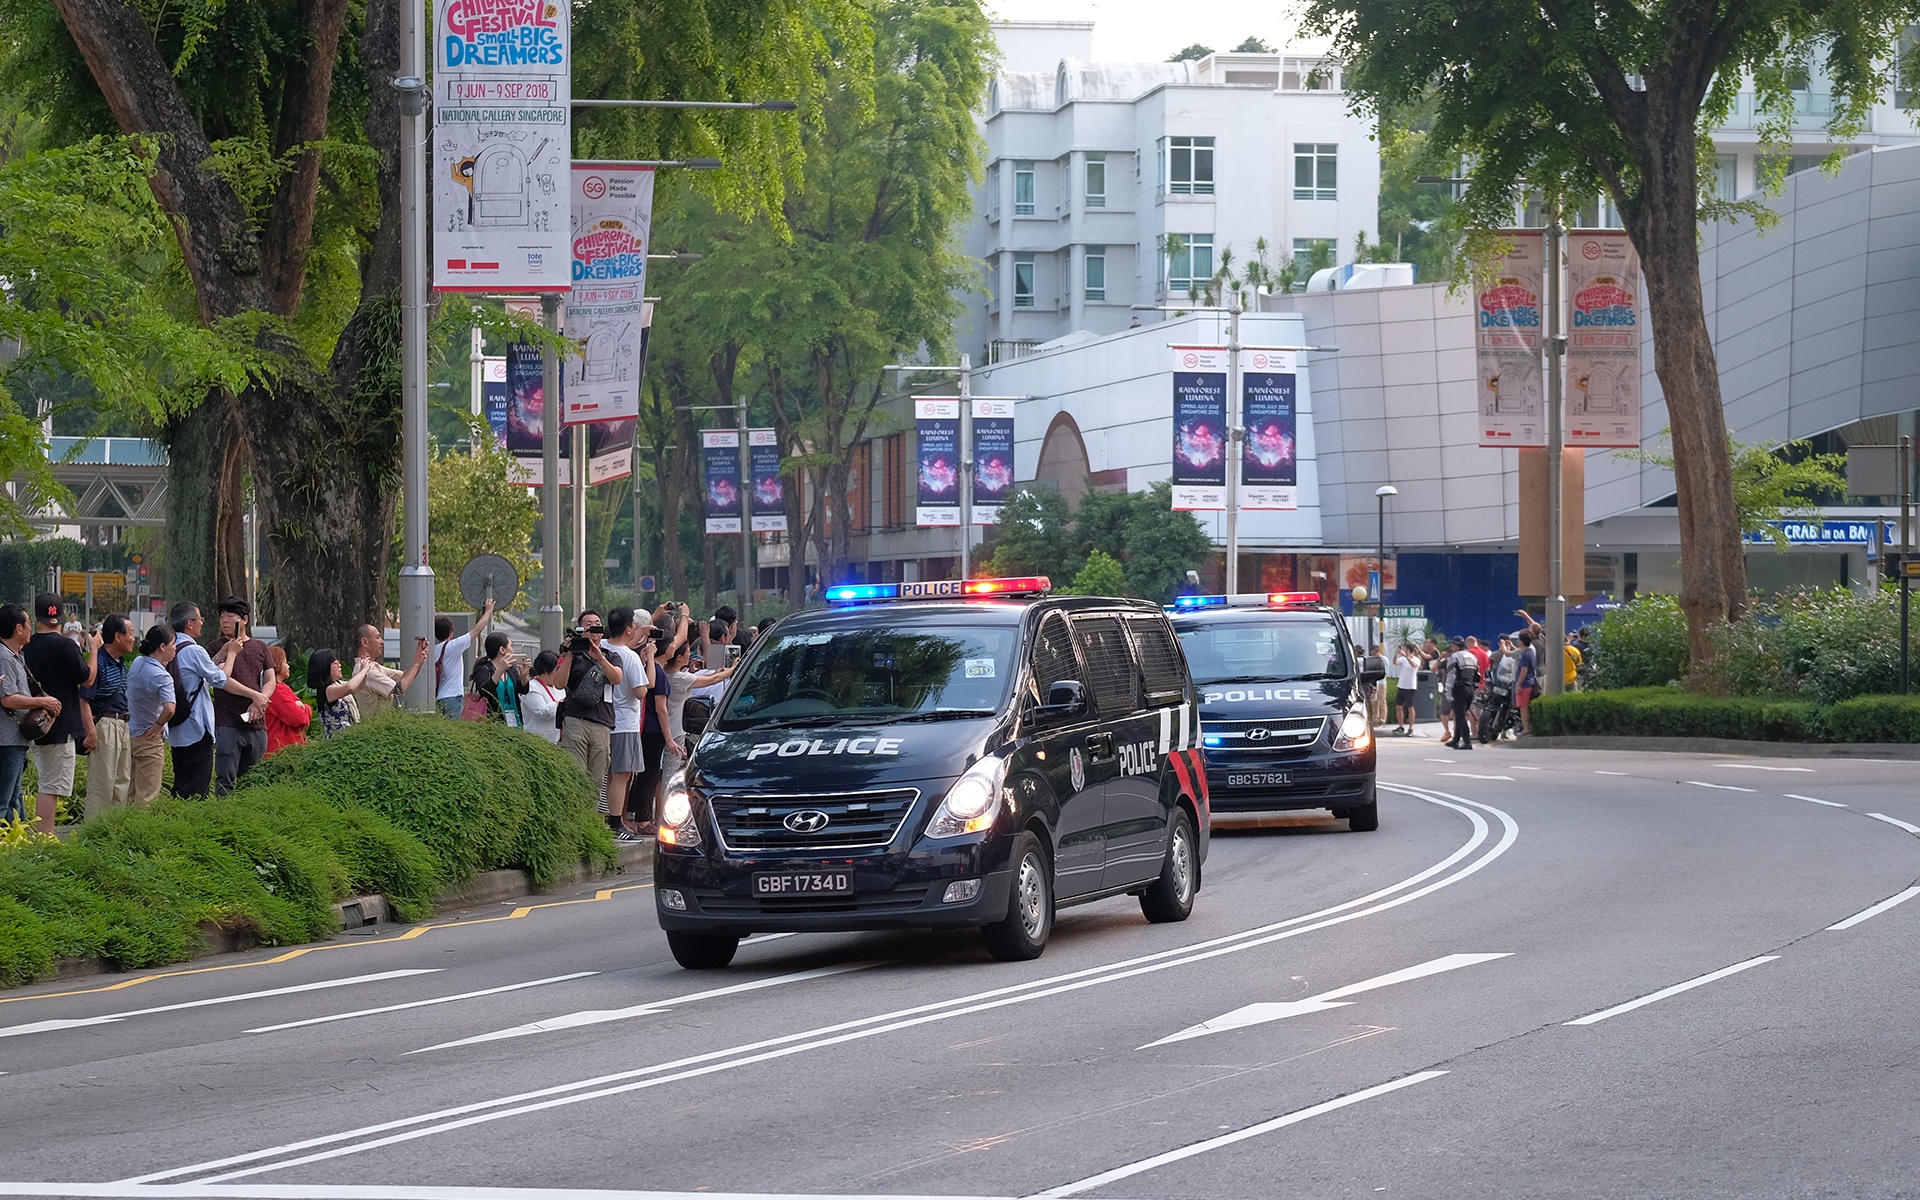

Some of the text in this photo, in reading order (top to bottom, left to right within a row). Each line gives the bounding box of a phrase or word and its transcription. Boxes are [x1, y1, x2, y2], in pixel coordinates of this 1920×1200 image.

[466, 1, 556, 42] FESTIVAL
[520, 27, 558, 46] BIG
[457, 84, 548, 98] 9 JUN 9 SEP 2018
[442, 110, 562, 122] NATIONAL GALLERY SINGAPORE
[586, 183, 603, 192] SG
[585, 237, 640, 265] FESTIVAL
[620, 254, 640, 267] BIG
[584, 292, 597, 300] JUN
[608, 290, 619, 300] SEP
[1518, 306, 1537, 316] BIG
[1613, 305, 1633, 316] BIG
[1849, 526, 1867, 539] BA
[903, 582, 960, 596] POLICE
[1204, 690, 1311, 704] POLICE
[746, 738, 904, 761] POLICE
[1119, 741, 1157, 777] POLICE
[1228, 774, 1291, 785] GBC5762L
[758, 875, 847, 892] GBF1734D
